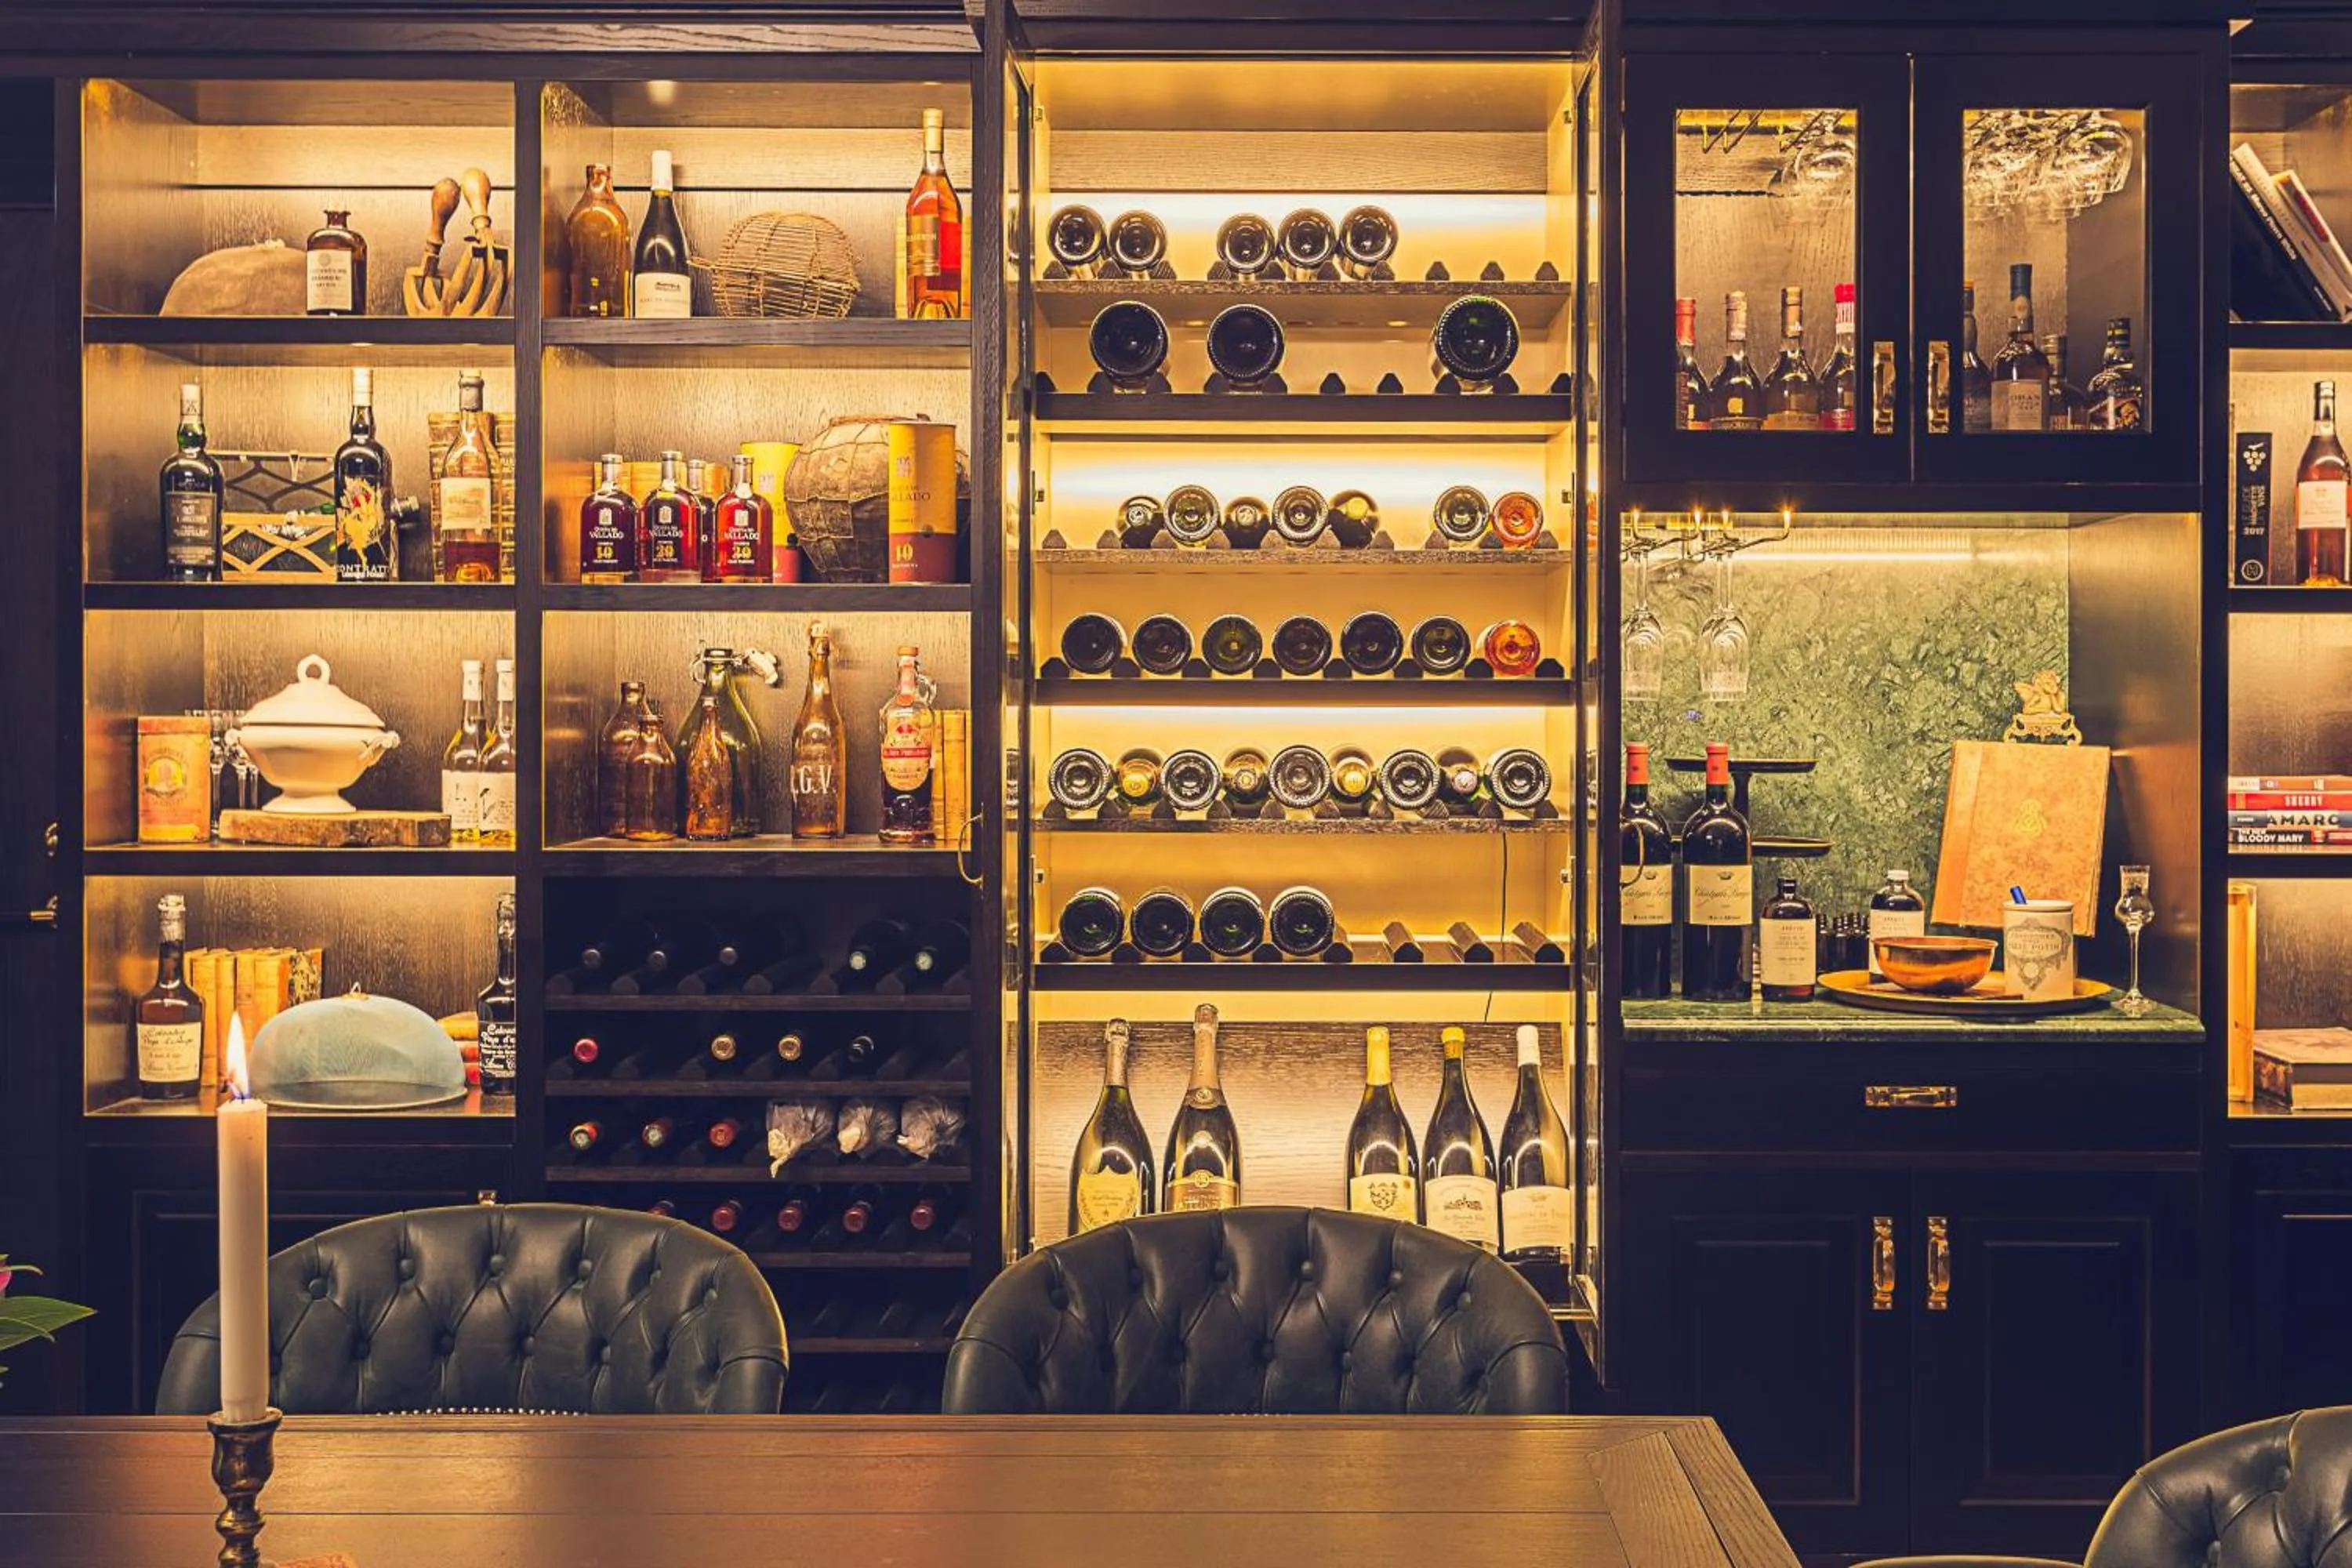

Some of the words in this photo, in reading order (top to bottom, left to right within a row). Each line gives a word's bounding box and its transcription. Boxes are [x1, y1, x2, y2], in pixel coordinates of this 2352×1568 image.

[589, 531, 625, 539] VALLADO
[648, 529, 684, 539] VALLADO
[2243, 527, 2265, 535] 2017
[597, 546, 613, 559] 10
[896, 543, 913, 562] 10
[2285, 795, 2323, 807] SHERRY
[2238, 833, 2276, 843] BLOODY
[2278, 833, 2304, 843] MARY
